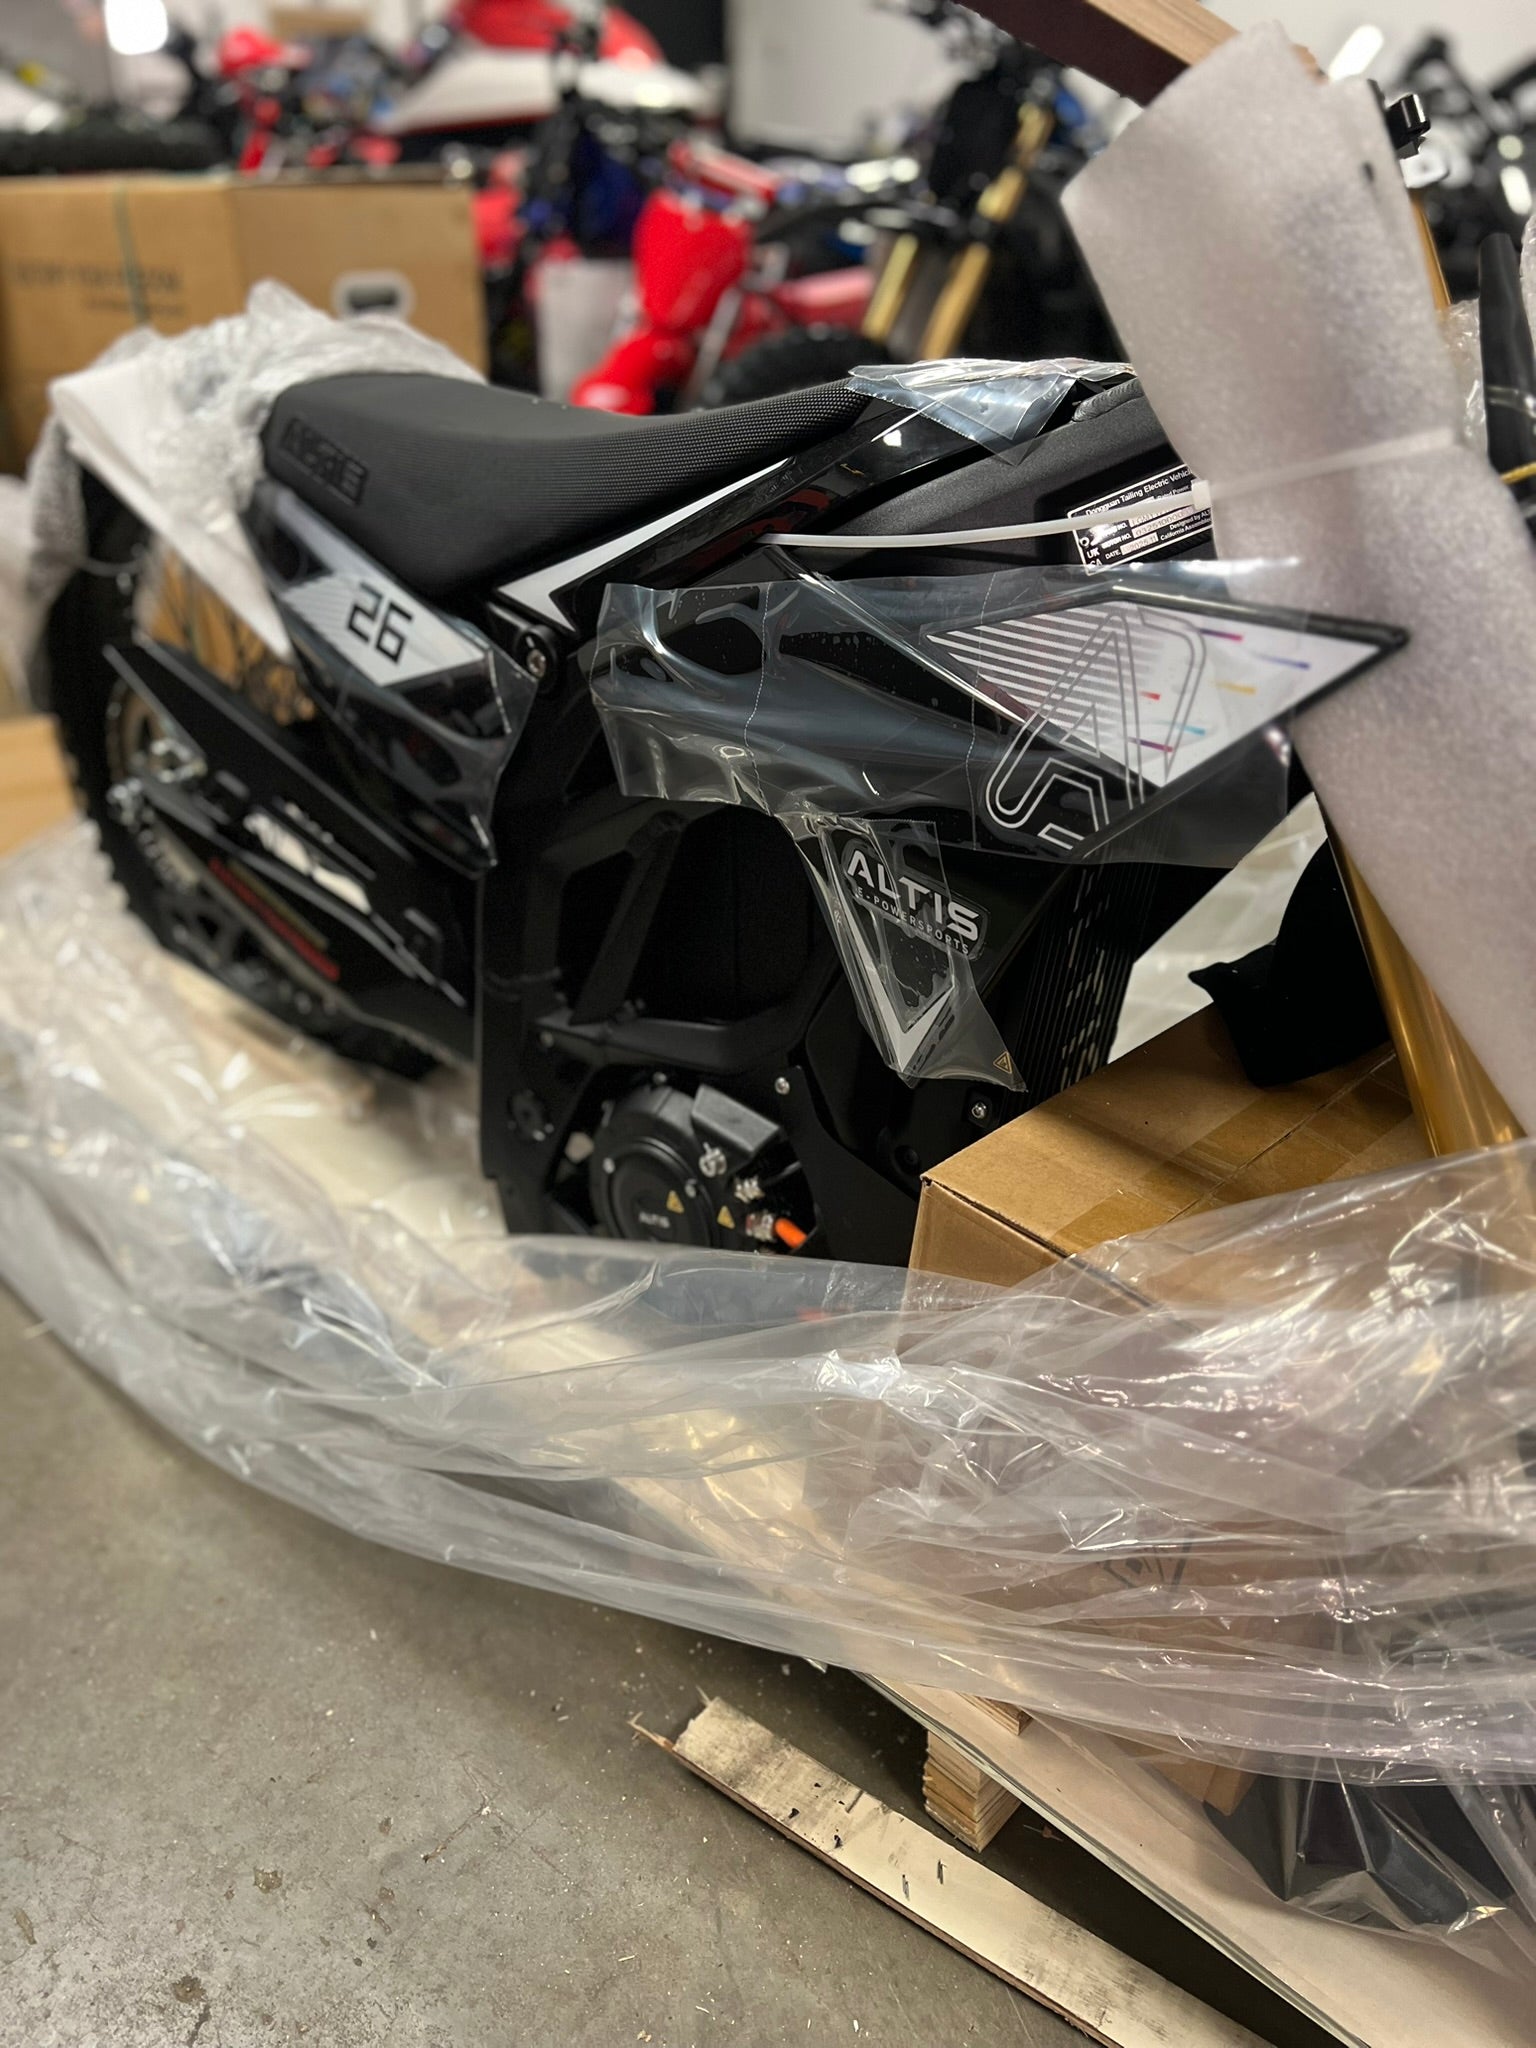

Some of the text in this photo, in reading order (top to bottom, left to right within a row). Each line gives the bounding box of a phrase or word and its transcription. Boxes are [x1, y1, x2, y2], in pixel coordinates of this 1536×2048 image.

[1144, 478, 1169, 493] Electric
[1169, 517, 1194, 530] Designed
[1194, 513, 1201, 522] by
[1160, 527, 1185, 541] California
[1087, 547, 1100, 558] UK
[347, 582, 413, 662] 26
[847, 850, 979, 941] ALTIS
[856, 886, 969, 955] E-POWERSPORTS
